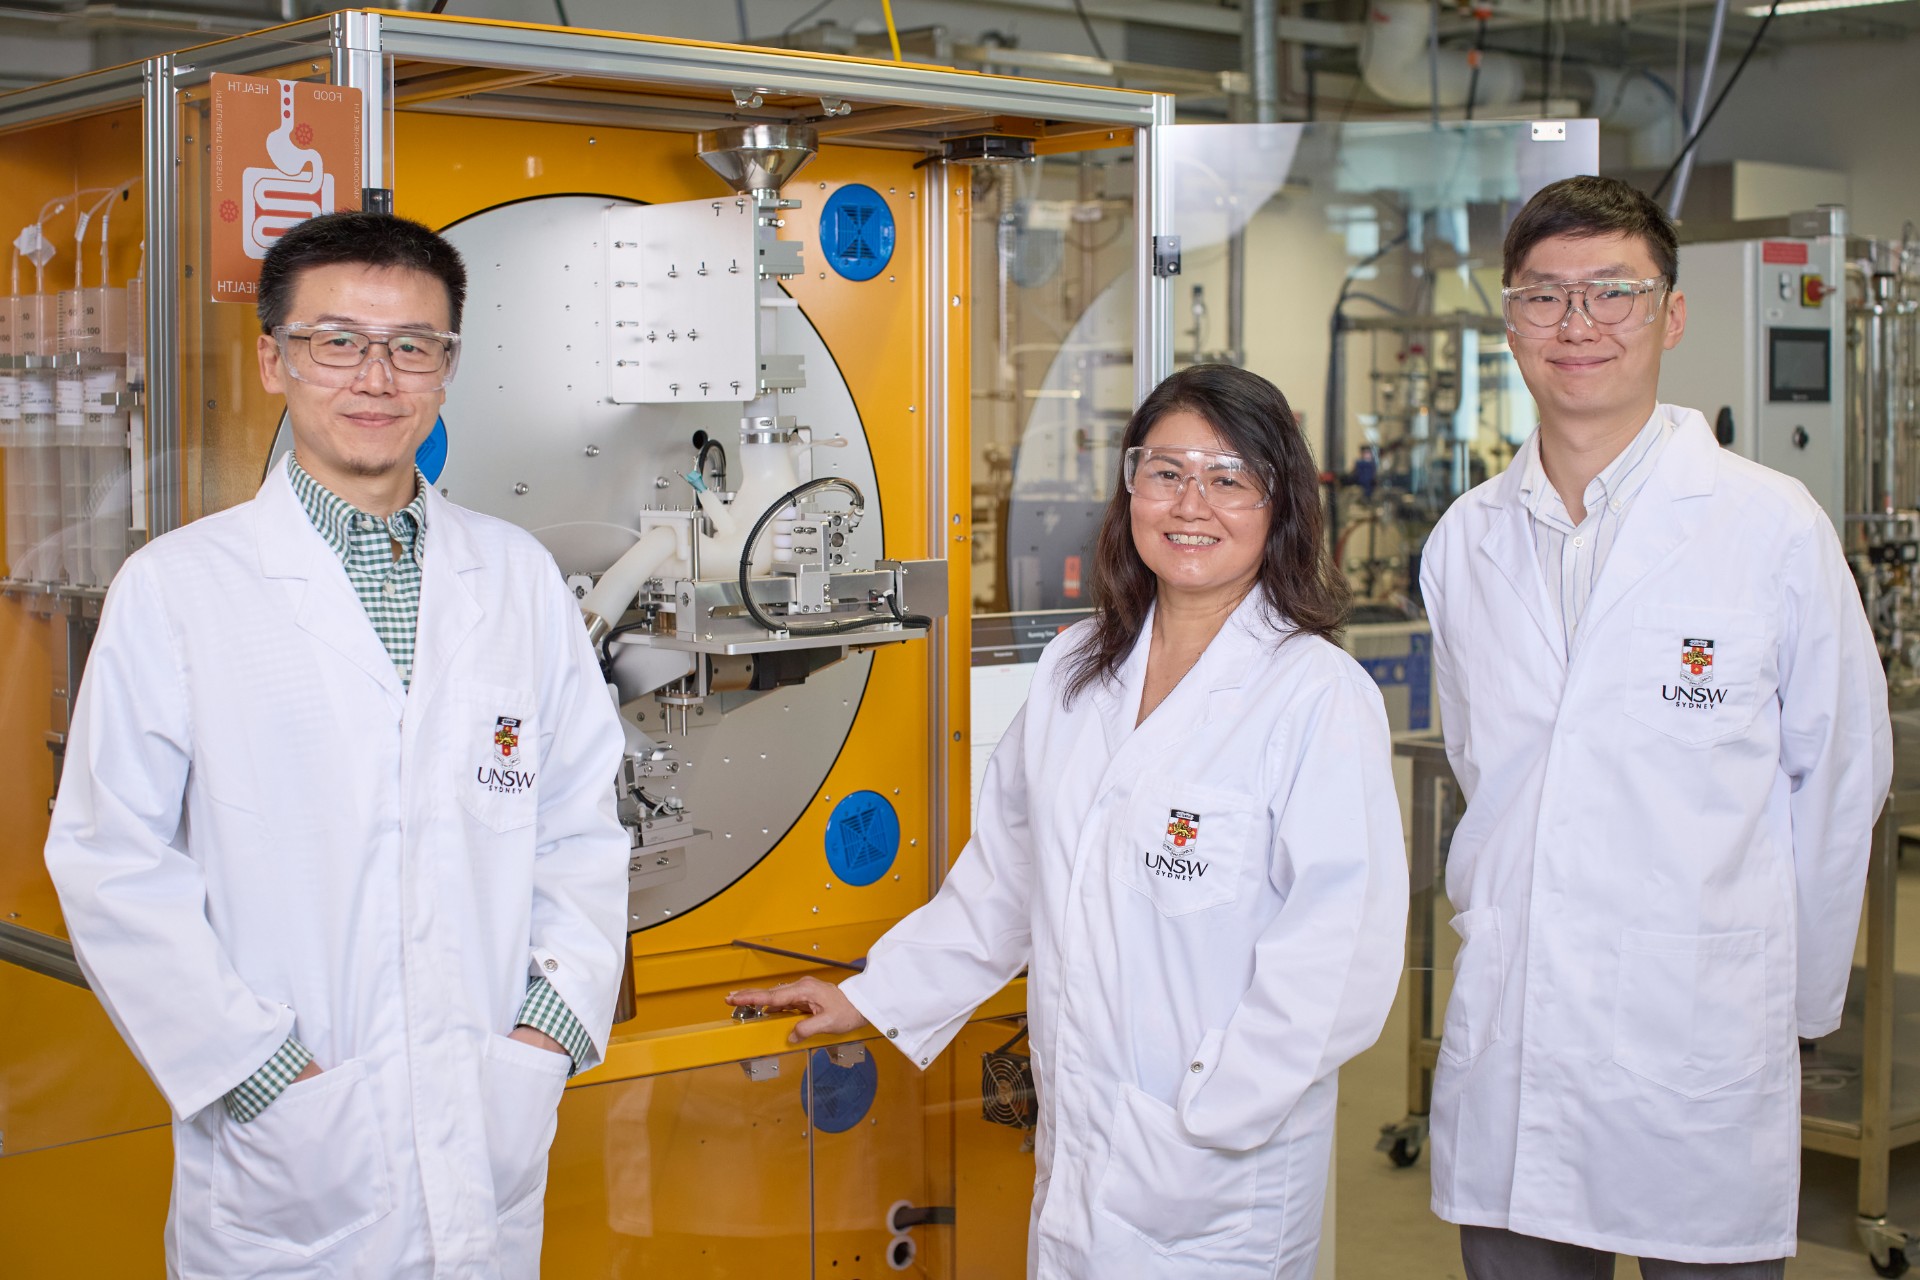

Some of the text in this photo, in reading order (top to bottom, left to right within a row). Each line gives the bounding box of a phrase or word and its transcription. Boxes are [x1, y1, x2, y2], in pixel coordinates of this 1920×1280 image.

[87, 327, 100, 335] 100
[1662, 685, 1728, 704] UNSW
[1675, 702, 1714, 710] SYDNEY
[477, 766, 536, 789] UNSW
[488, 785, 522, 794] SYDNEY
[1145, 851, 1209, 877] UNSW
[1155, 869, 1193, 881] SYDNEY
